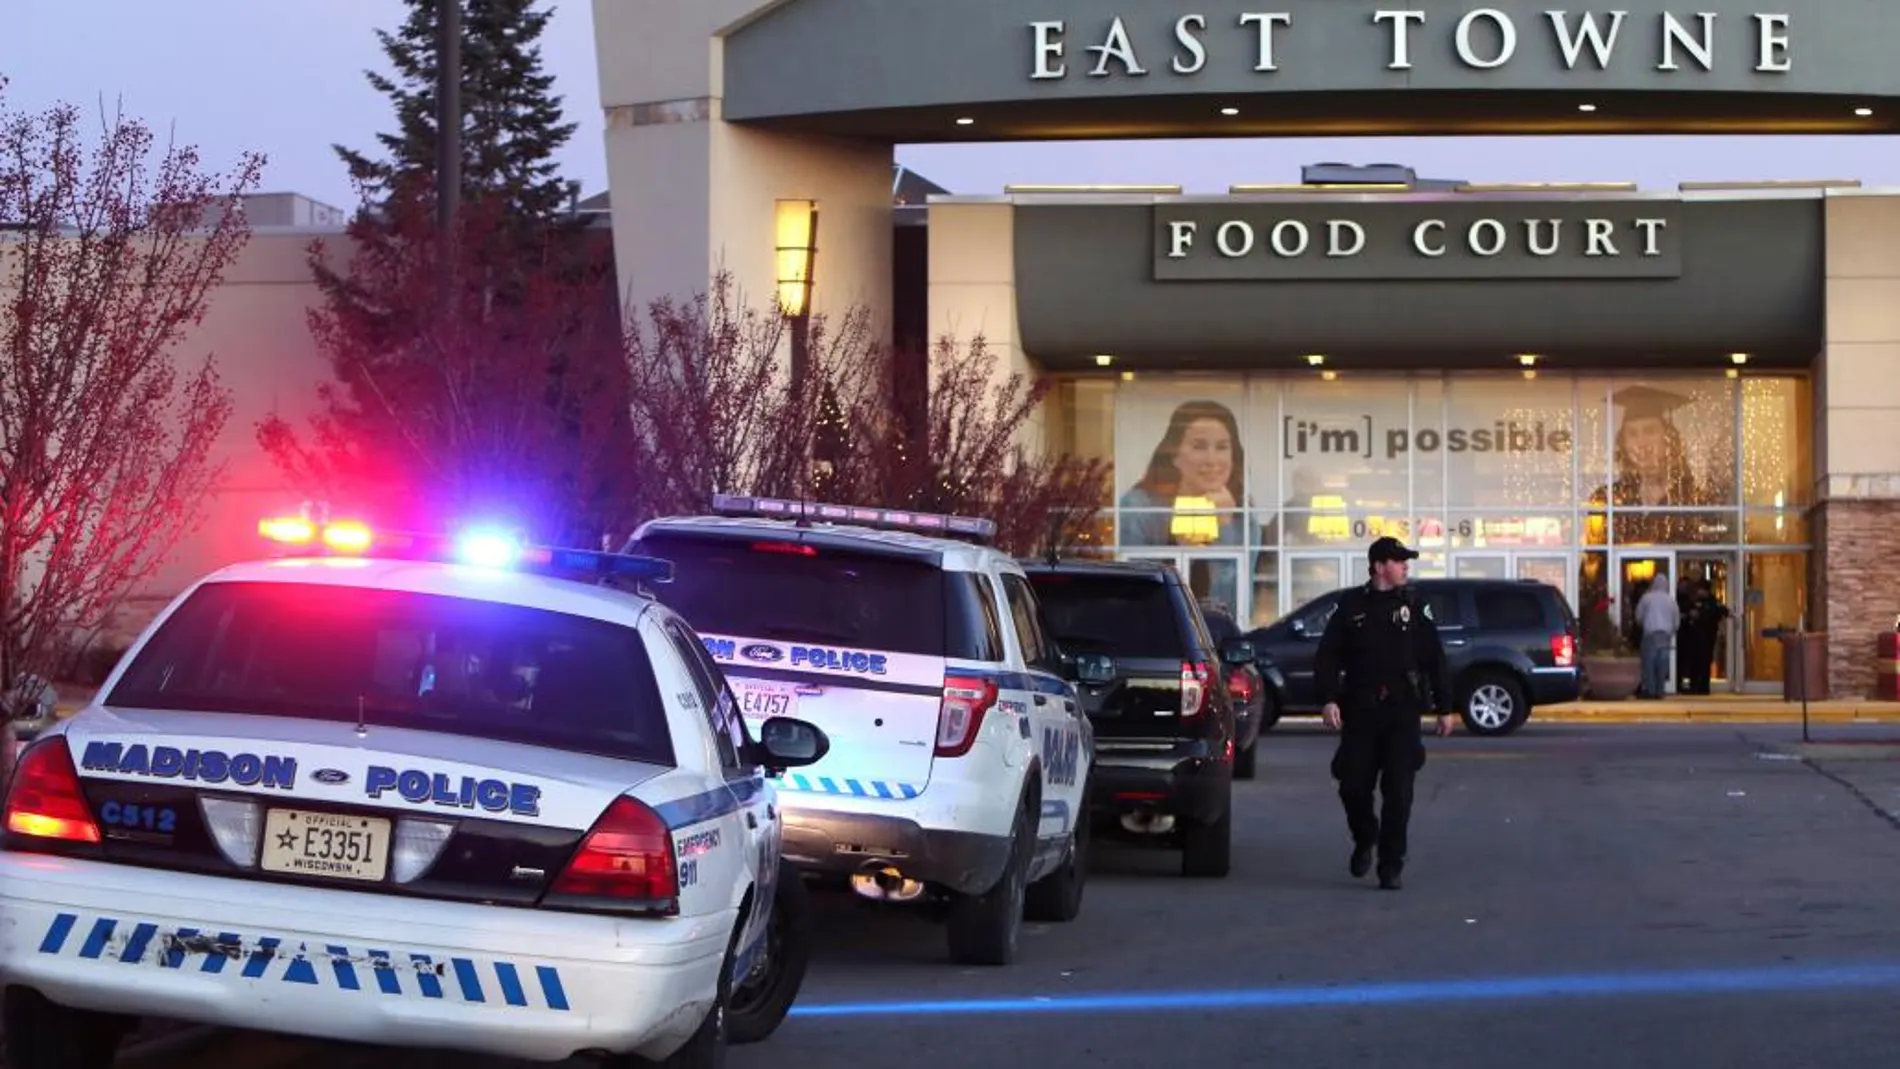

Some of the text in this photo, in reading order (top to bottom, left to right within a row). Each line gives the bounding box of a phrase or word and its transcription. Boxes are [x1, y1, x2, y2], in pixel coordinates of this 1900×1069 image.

[1028, 8, 1793, 81] EAST TOWNE
[1167, 218, 1668, 258] FOOD COURT
[1283, 415, 1574, 459] [i'm] possible
[789, 646, 888, 675] POLICE
[743, 691, 790, 715] E4757
[81, 740, 298, 790] MADISON
[365, 765, 541, 817] POLICE
[100, 800, 177, 832] C512
[305, 815, 353, 829] OFFICIAL
[303, 826, 373, 863] E3351
[677, 827, 721, 858] EMERGENCY
[294, 858, 353, 873] WISCONSIN
[679, 858, 698, 889] 911
